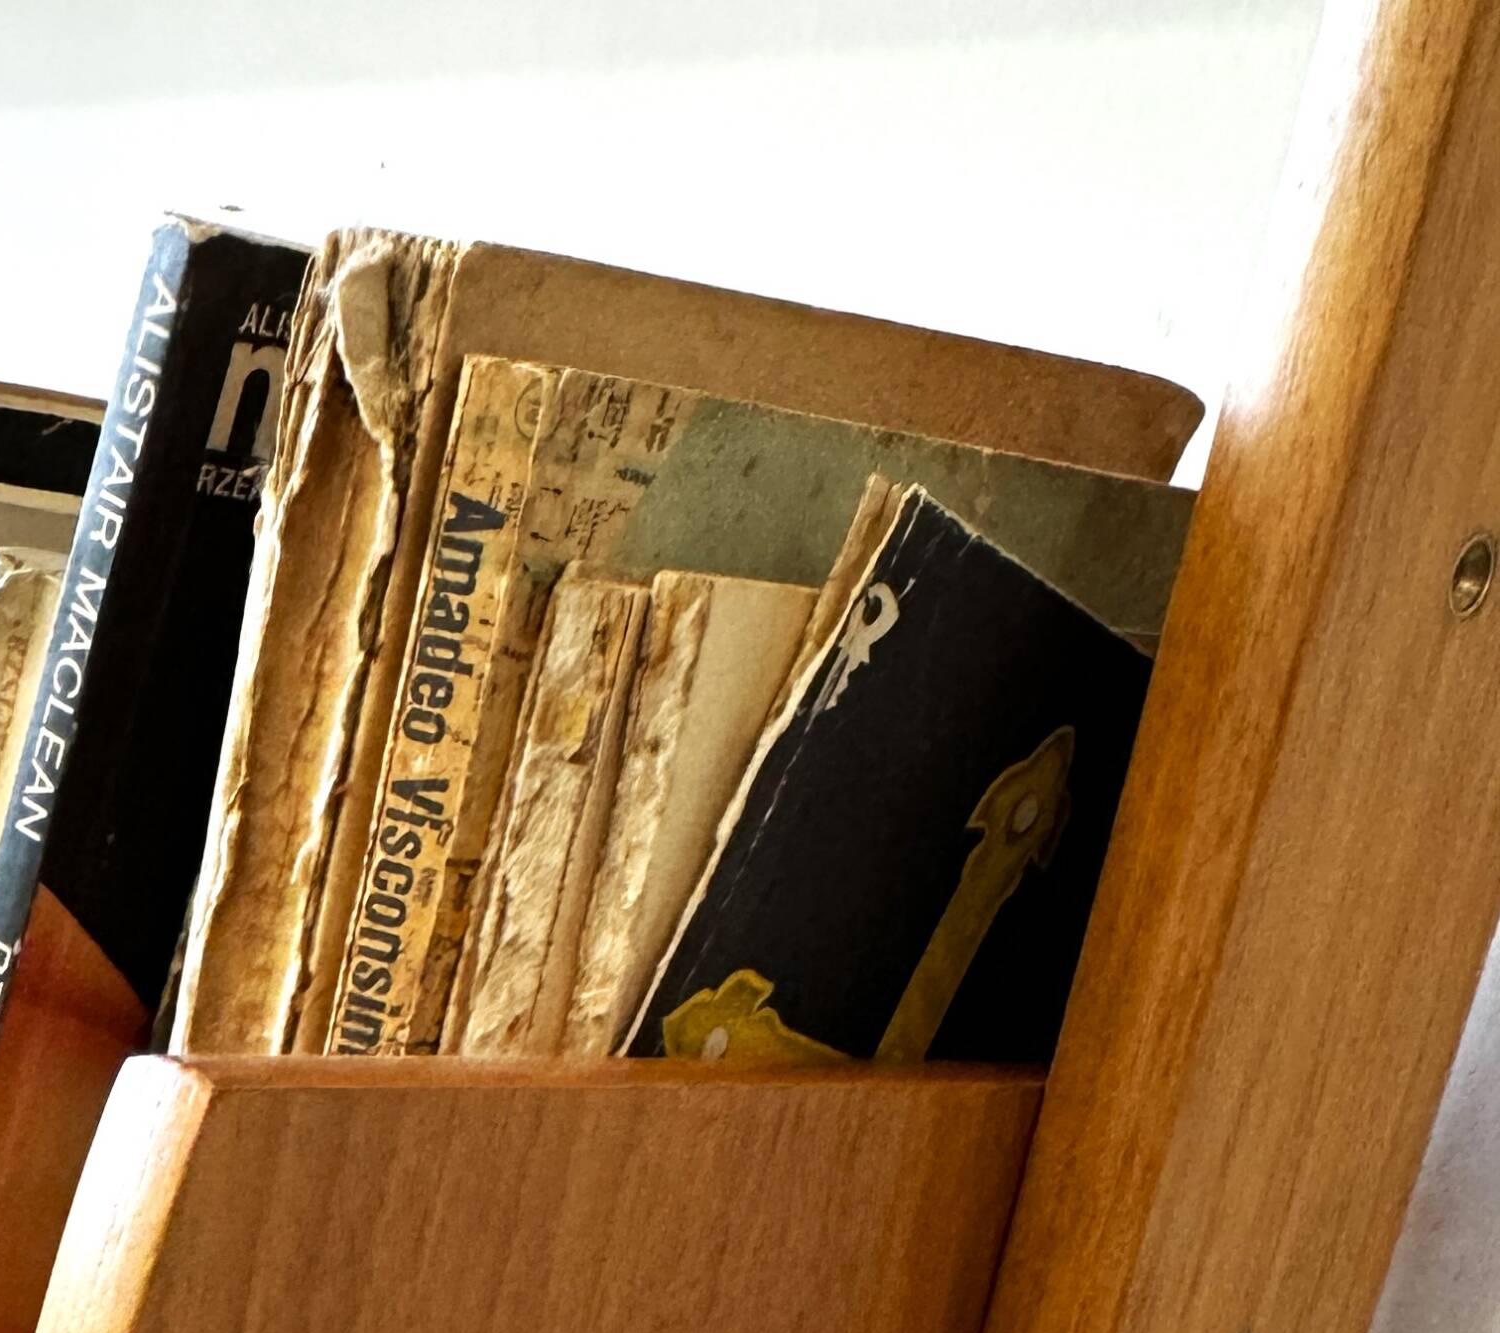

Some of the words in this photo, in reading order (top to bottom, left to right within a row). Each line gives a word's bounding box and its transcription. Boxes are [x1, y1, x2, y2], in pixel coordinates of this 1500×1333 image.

[89, 272, 178, 550] ALISTAIR
[14, 569, 109, 843] MACLEAN
[402, 492, 507, 746] Amadeo
